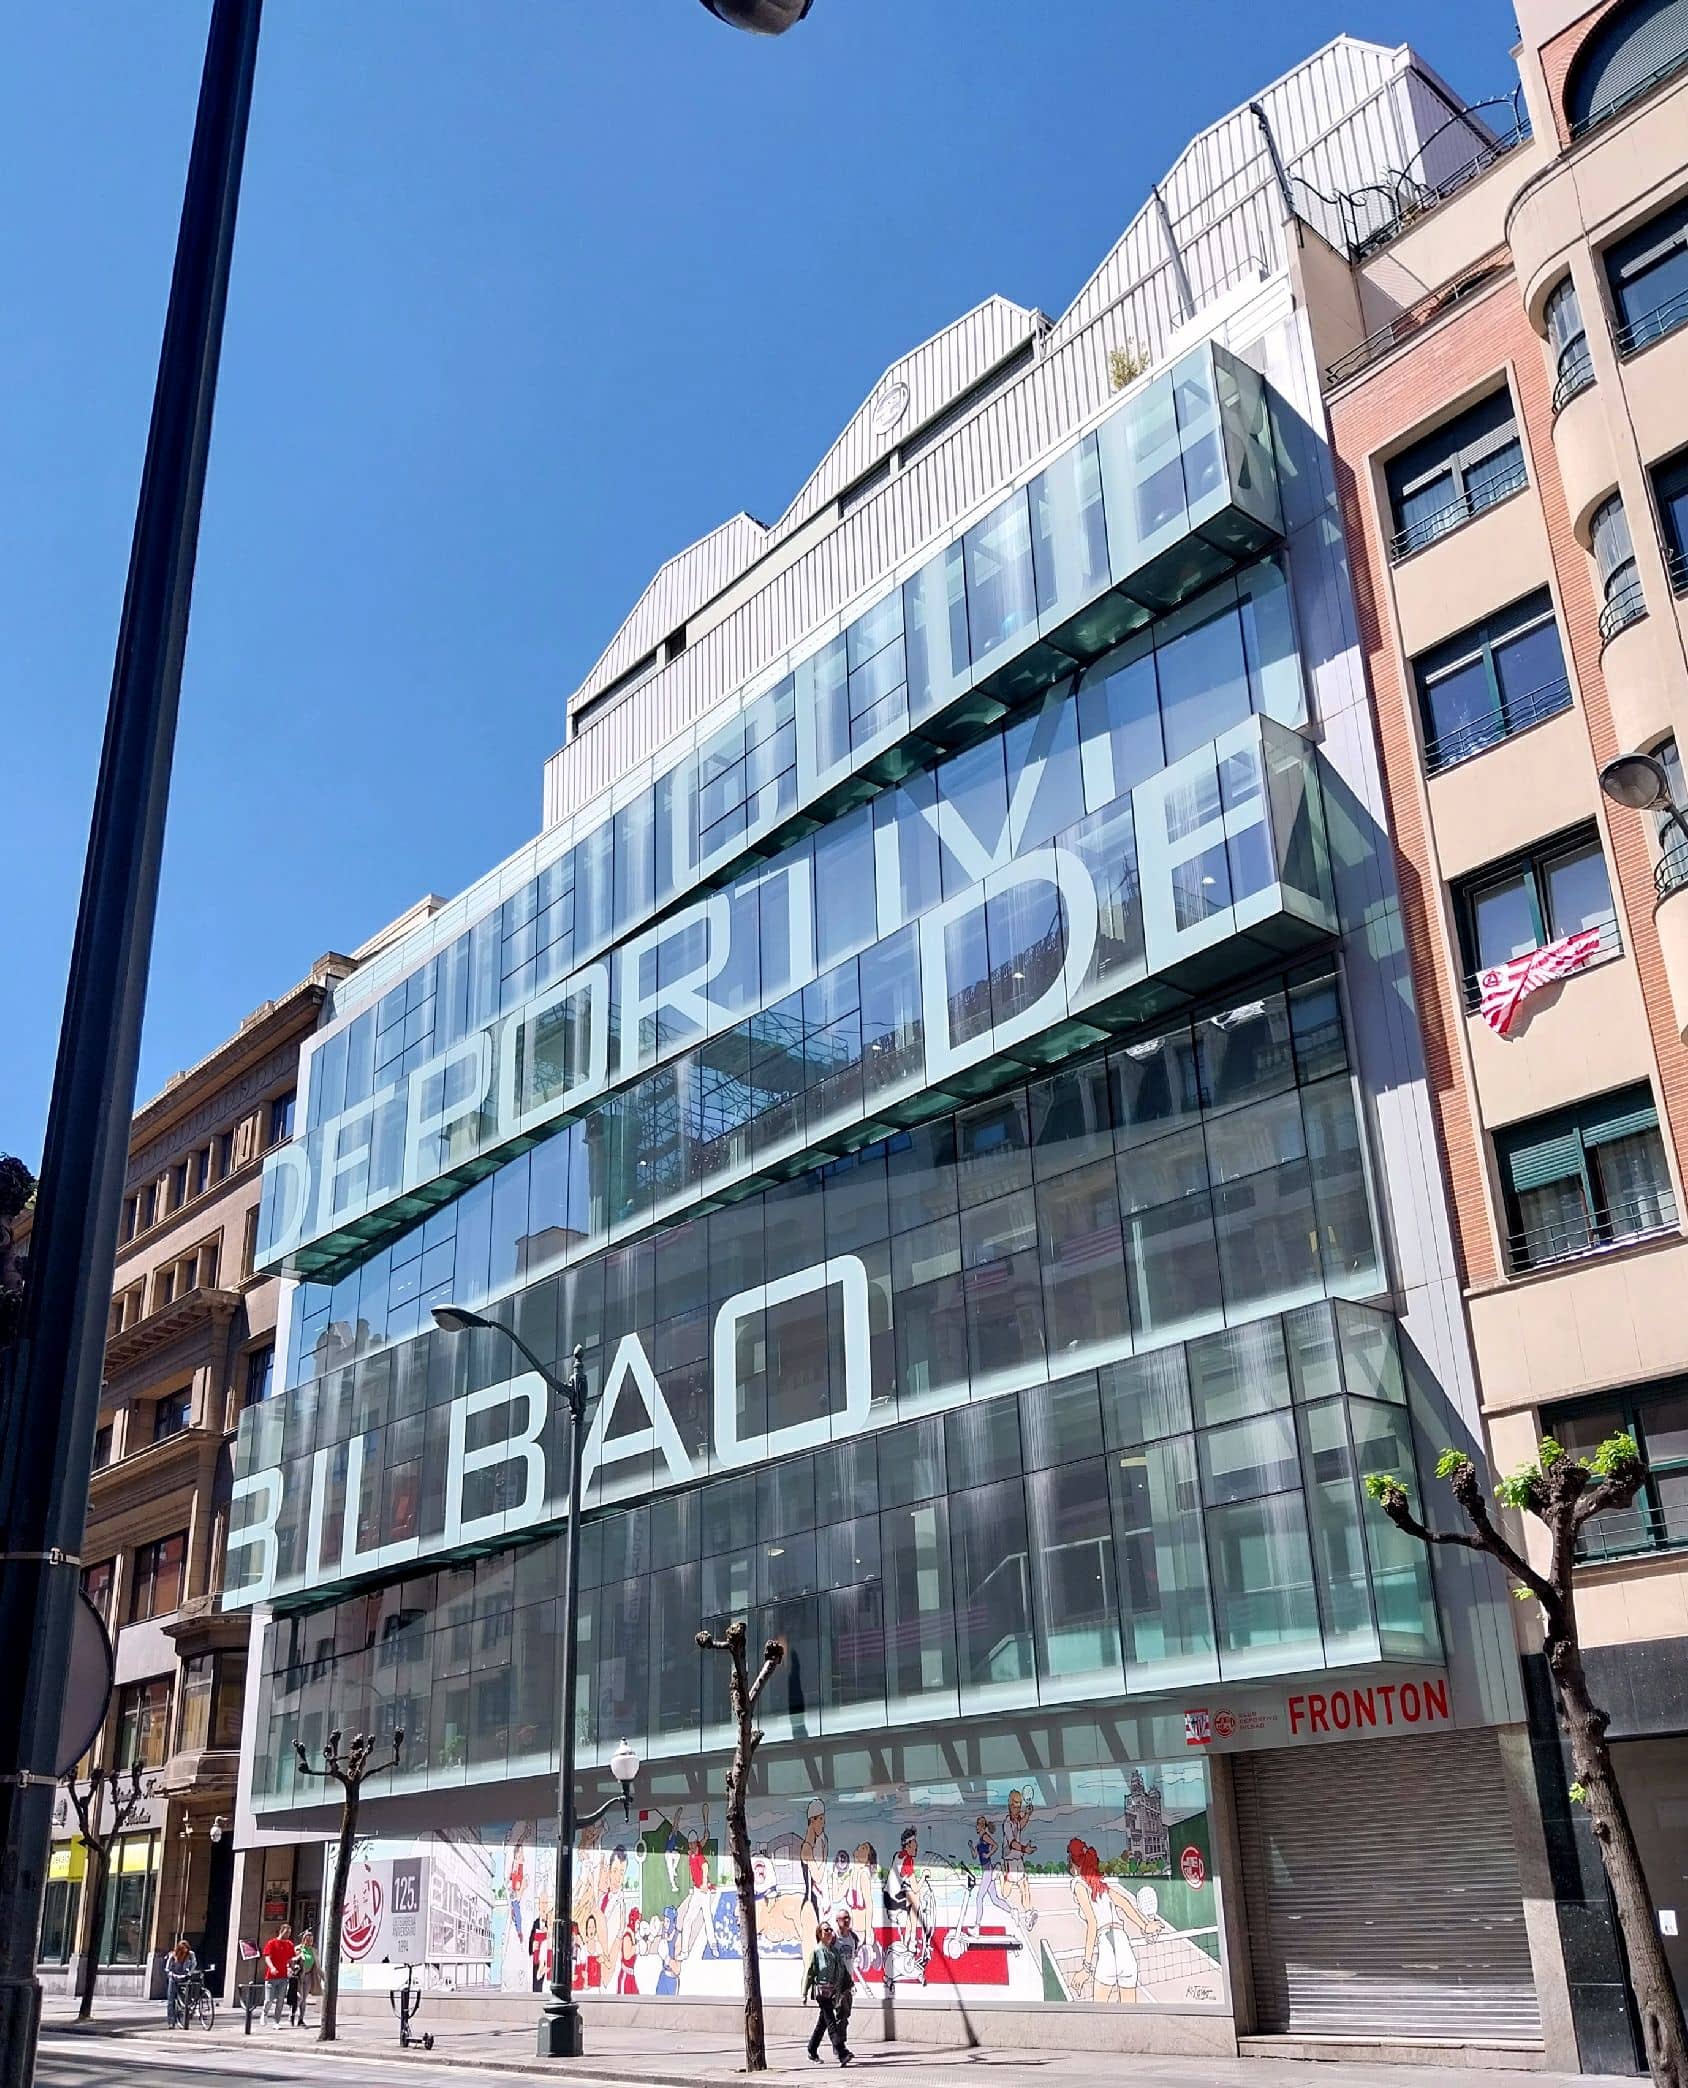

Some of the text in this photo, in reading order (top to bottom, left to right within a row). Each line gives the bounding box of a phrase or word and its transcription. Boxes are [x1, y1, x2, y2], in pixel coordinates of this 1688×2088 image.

[253, 555, 1312, 1273] DEPORTIVO
[918, 718, 1340, 1088] DE
[221, 1253, 873, 1612] BILBAO
[1288, 1679, 1449, 1735] FRONTON
[394, 1875, 417, 1911] 125.
